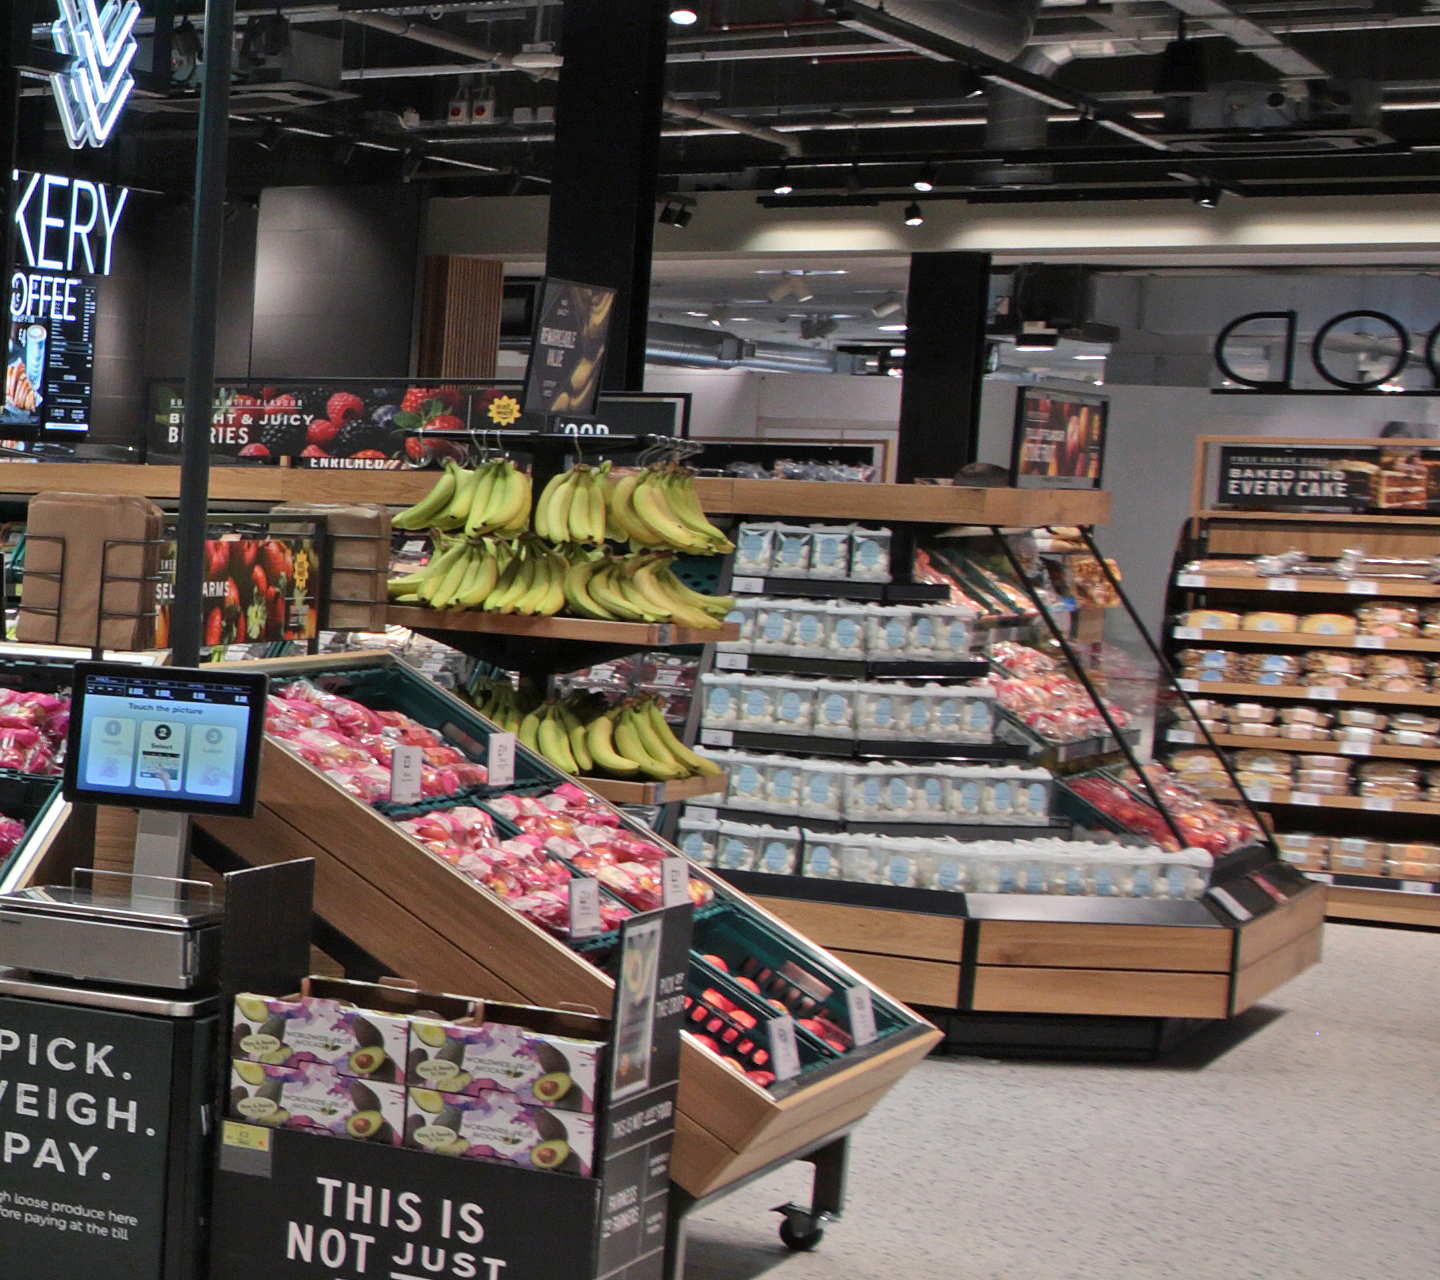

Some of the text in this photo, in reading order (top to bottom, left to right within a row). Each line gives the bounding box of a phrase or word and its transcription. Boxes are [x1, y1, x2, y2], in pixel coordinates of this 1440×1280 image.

[10, 271, 80, 322] OFFEE
[241, 413, 314, 426] & JUICY
[168, 426, 250, 444] BRIES
[1228, 467, 1345, 481] BAKED INTO
[1227, 480, 1348, 498] EVERY CAKE
[128, 702, 204, 717] Touch the picture
[150, 742, 173, 751] Select
[3, 1130, 112, 1181] PAY.
[13, 1193, 49, 1210] loose
[51, 1201, 106, 1222] produce
[108, 1209, 139, 1227] here
[315, 1176, 485, 1245] THIS IS
[23, 1211, 67, 1232] paying
[68, 1219, 83, 1233] at
[85, 1220, 109, 1237] the
[110, 1225, 130, 1242] till
[286, 1220, 376, 1274] NOT
